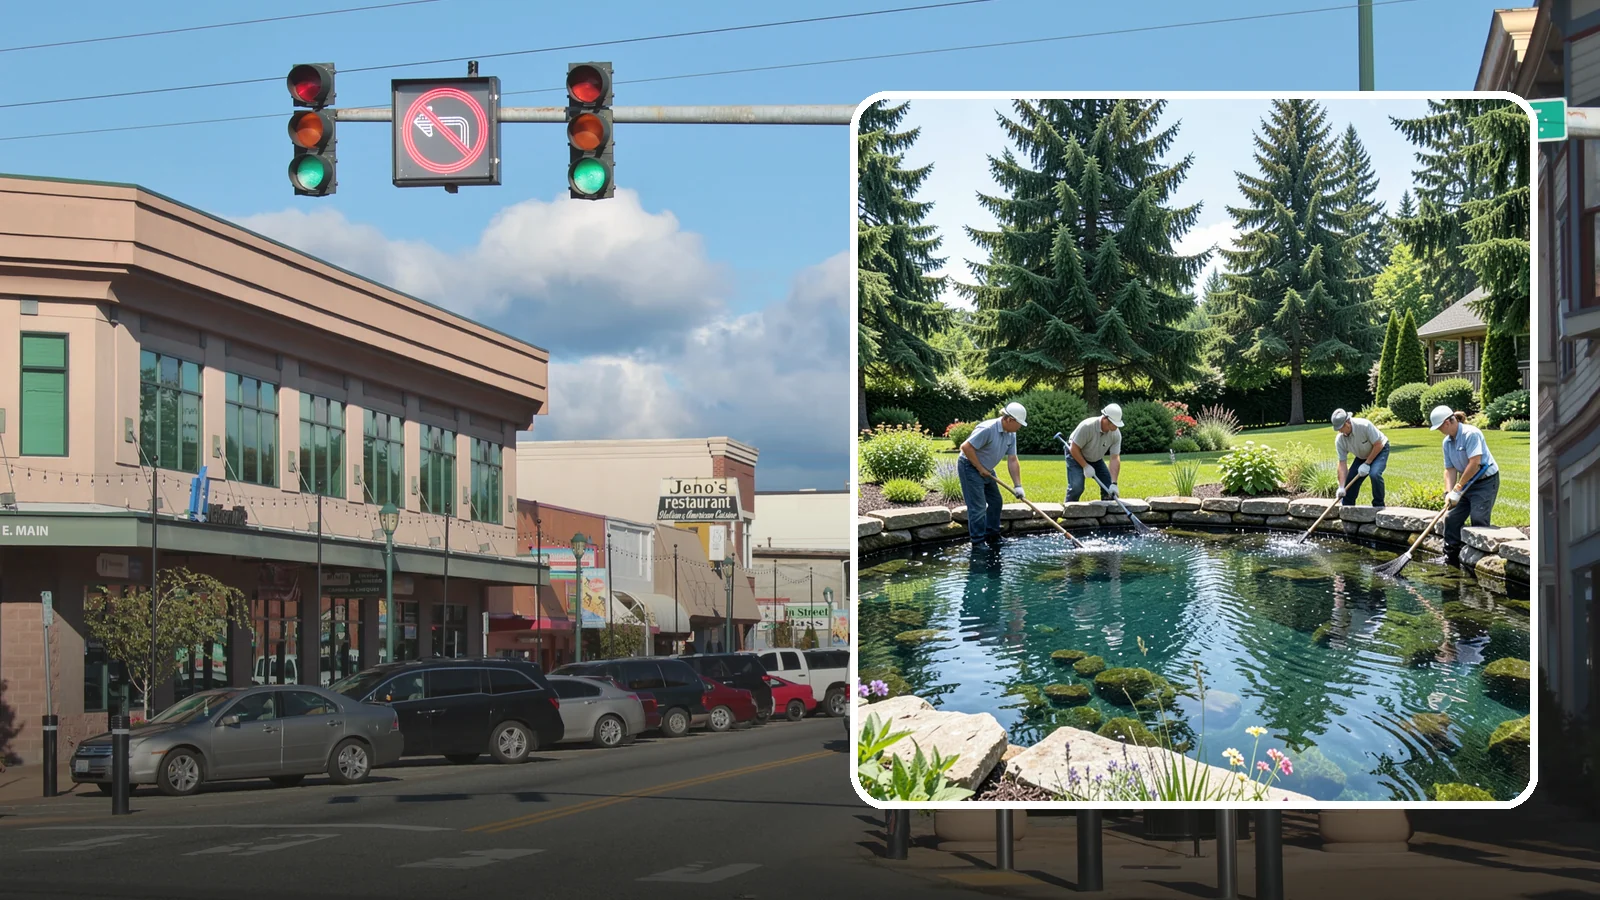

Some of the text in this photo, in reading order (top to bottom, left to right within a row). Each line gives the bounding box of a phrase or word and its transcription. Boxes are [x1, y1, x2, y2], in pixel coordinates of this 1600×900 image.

[669, 480, 728, 494] Jeno's
[665, 496, 731, 509] restaurant
[658, 510, 682, 519] Italian
[686, 510, 714, 519] American
[715, 509, 738, 519] Cuisine
[2, 525, 49, 536] E. MAIN
[797, 607, 829, 617] Street
